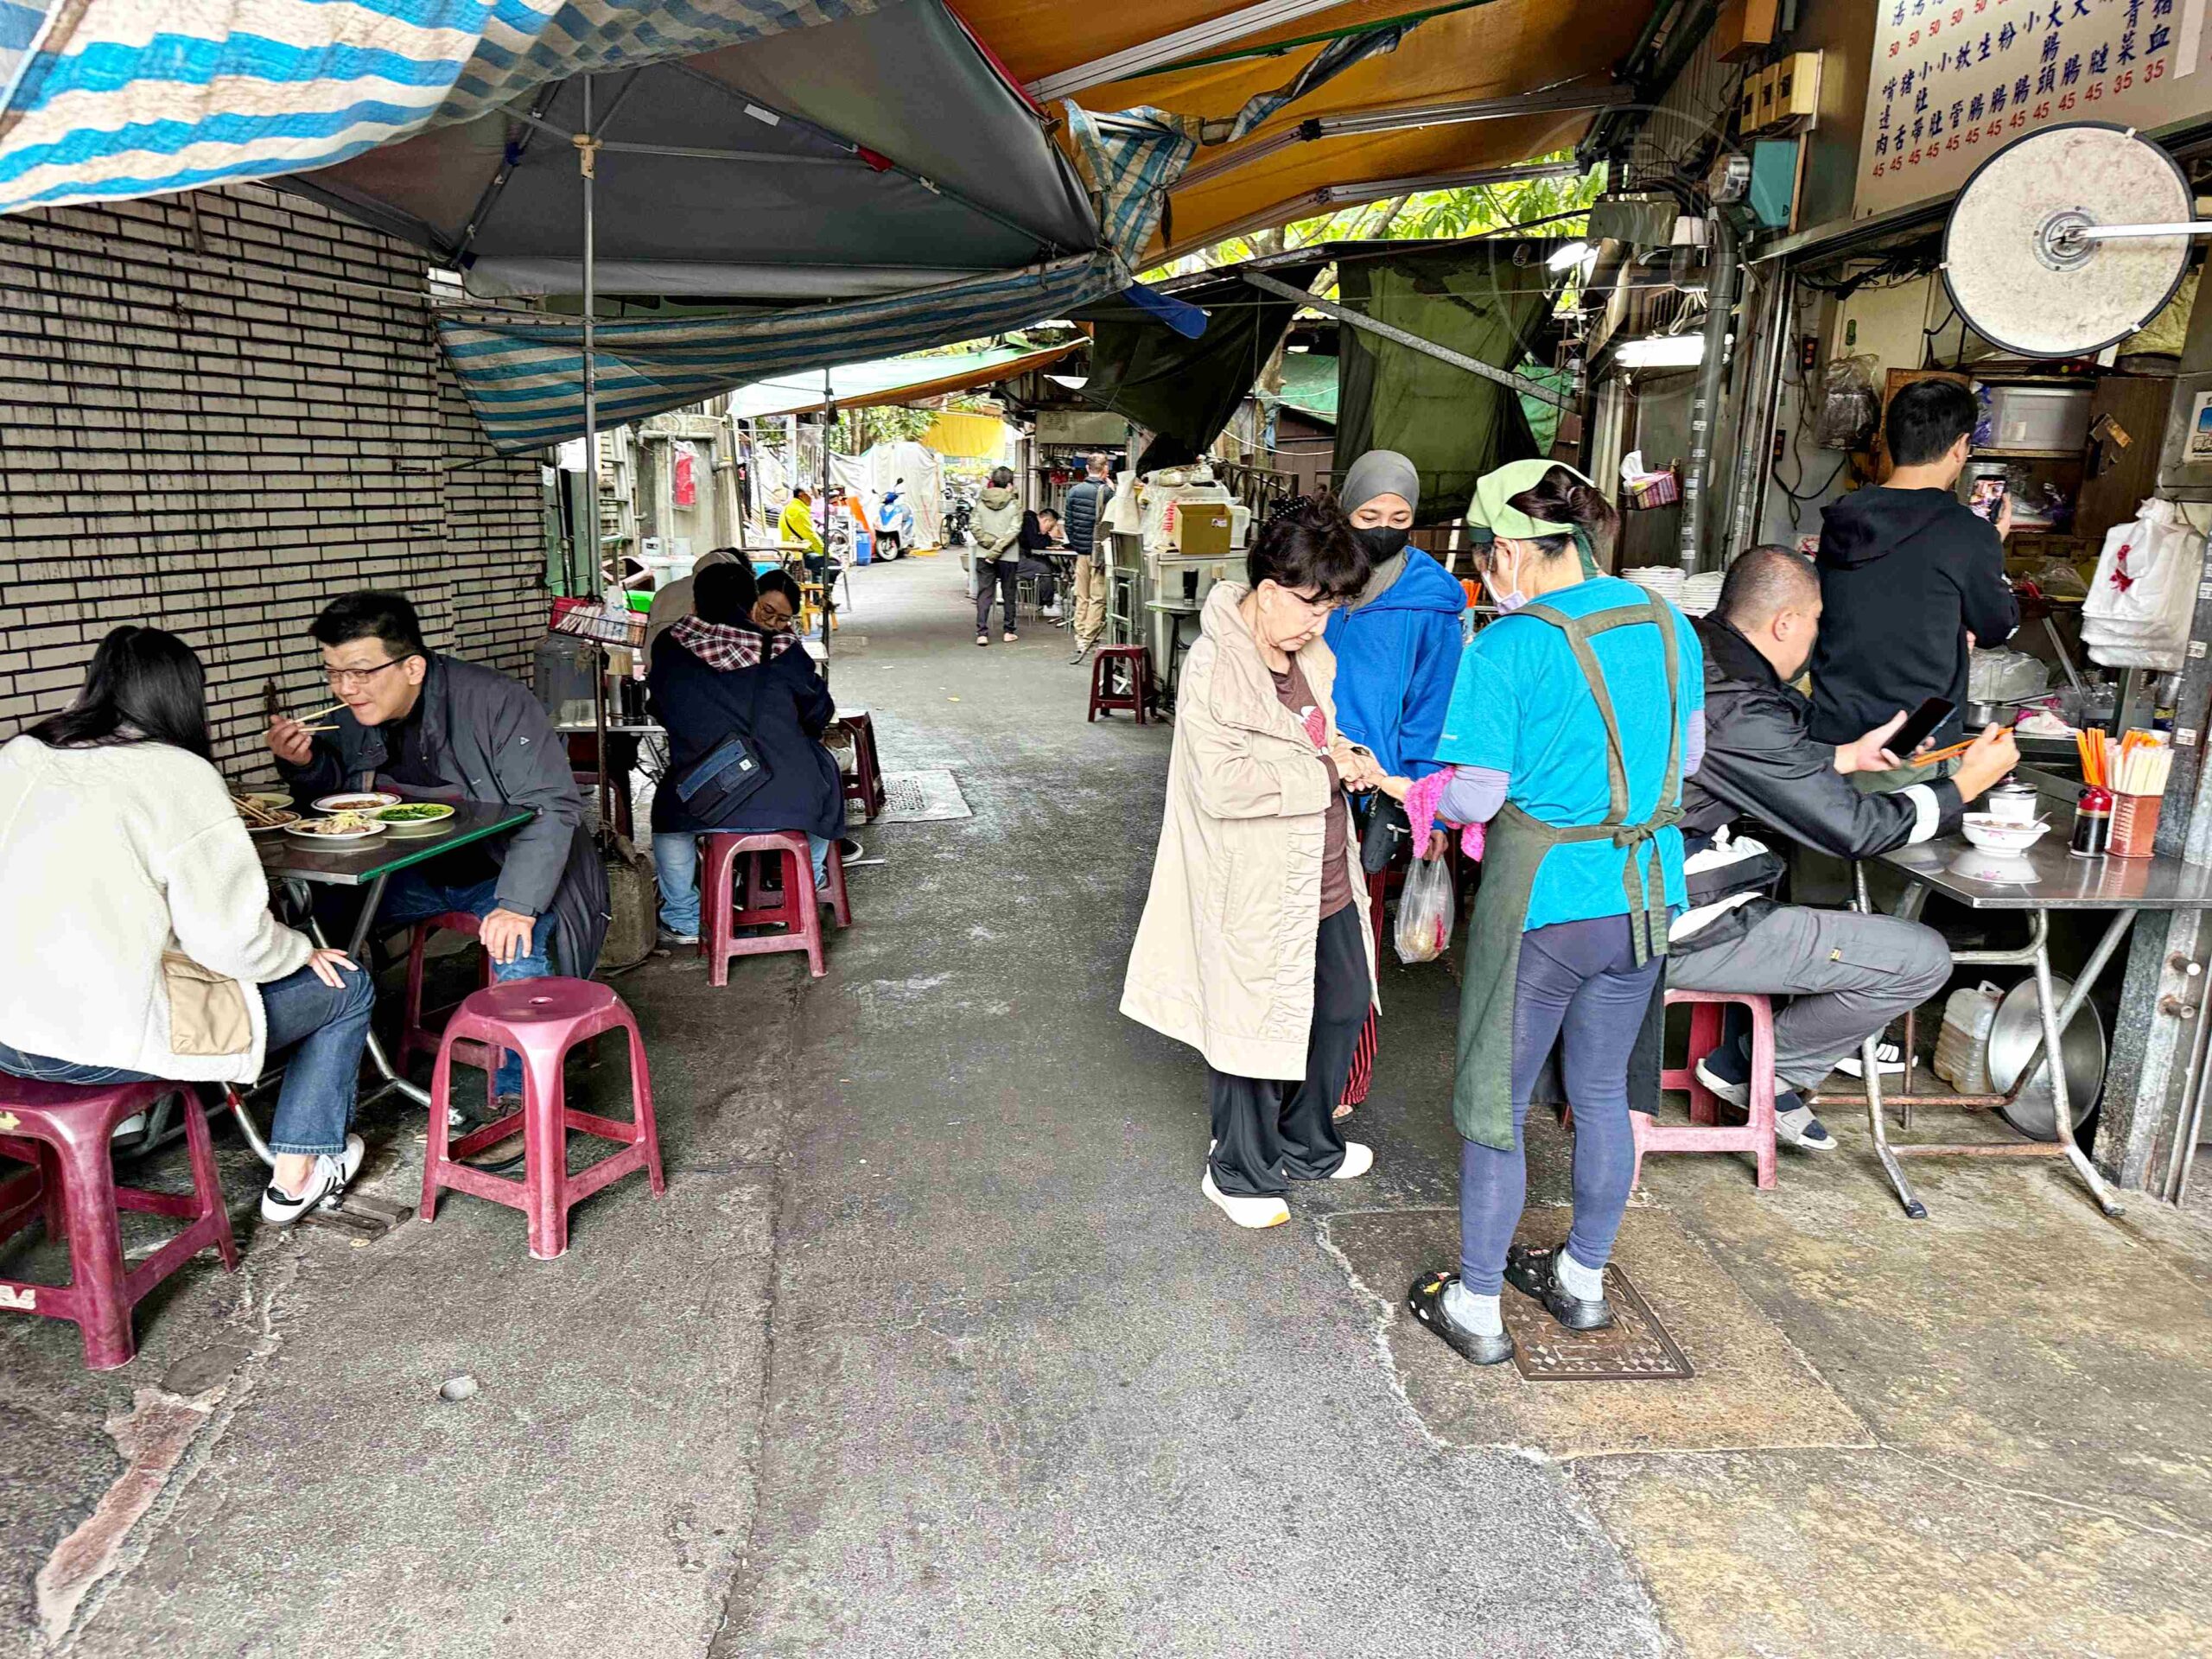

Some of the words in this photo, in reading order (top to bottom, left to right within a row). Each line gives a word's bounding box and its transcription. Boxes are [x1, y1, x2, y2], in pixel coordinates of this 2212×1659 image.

[1950, 8, 1964, 26] 50
[1929, 19, 1941, 36] 50
[2116, 0, 2145, 66] 青菜
[1908, 30, 1920, 48] 50
[2035, 0, 2063, 95] 大腸頭
[1889, 41, 1900, 58] 50
[2012, 11, 2040, 105] 小腸
[1967, 32, 1991, 123] 生腸
[1989, 22, 2017, 114] 粉腸
[2144, 57, 2165, 84] 35
[2084, 81, 2103, 102] 45
[2113, 70, 2133, 94] 35
[1929, 52, 1952, 137] 小肚
[2058, 92, 2075, 111] 45
[2010, 110, 2025, 129] 45
[2033, 101, 2050, 120] 45
[1966, 127, 1980, 144] 45
[1986, 119, 2002, 137] 45
[1926, 142, 1940, 158] 45
[1946, 135, 1960, 151] 45
[1890, 156, 1903, 170] 45
[1908, 149, 1921, 165] 45
[1872, 162, 1885, 177] 45
